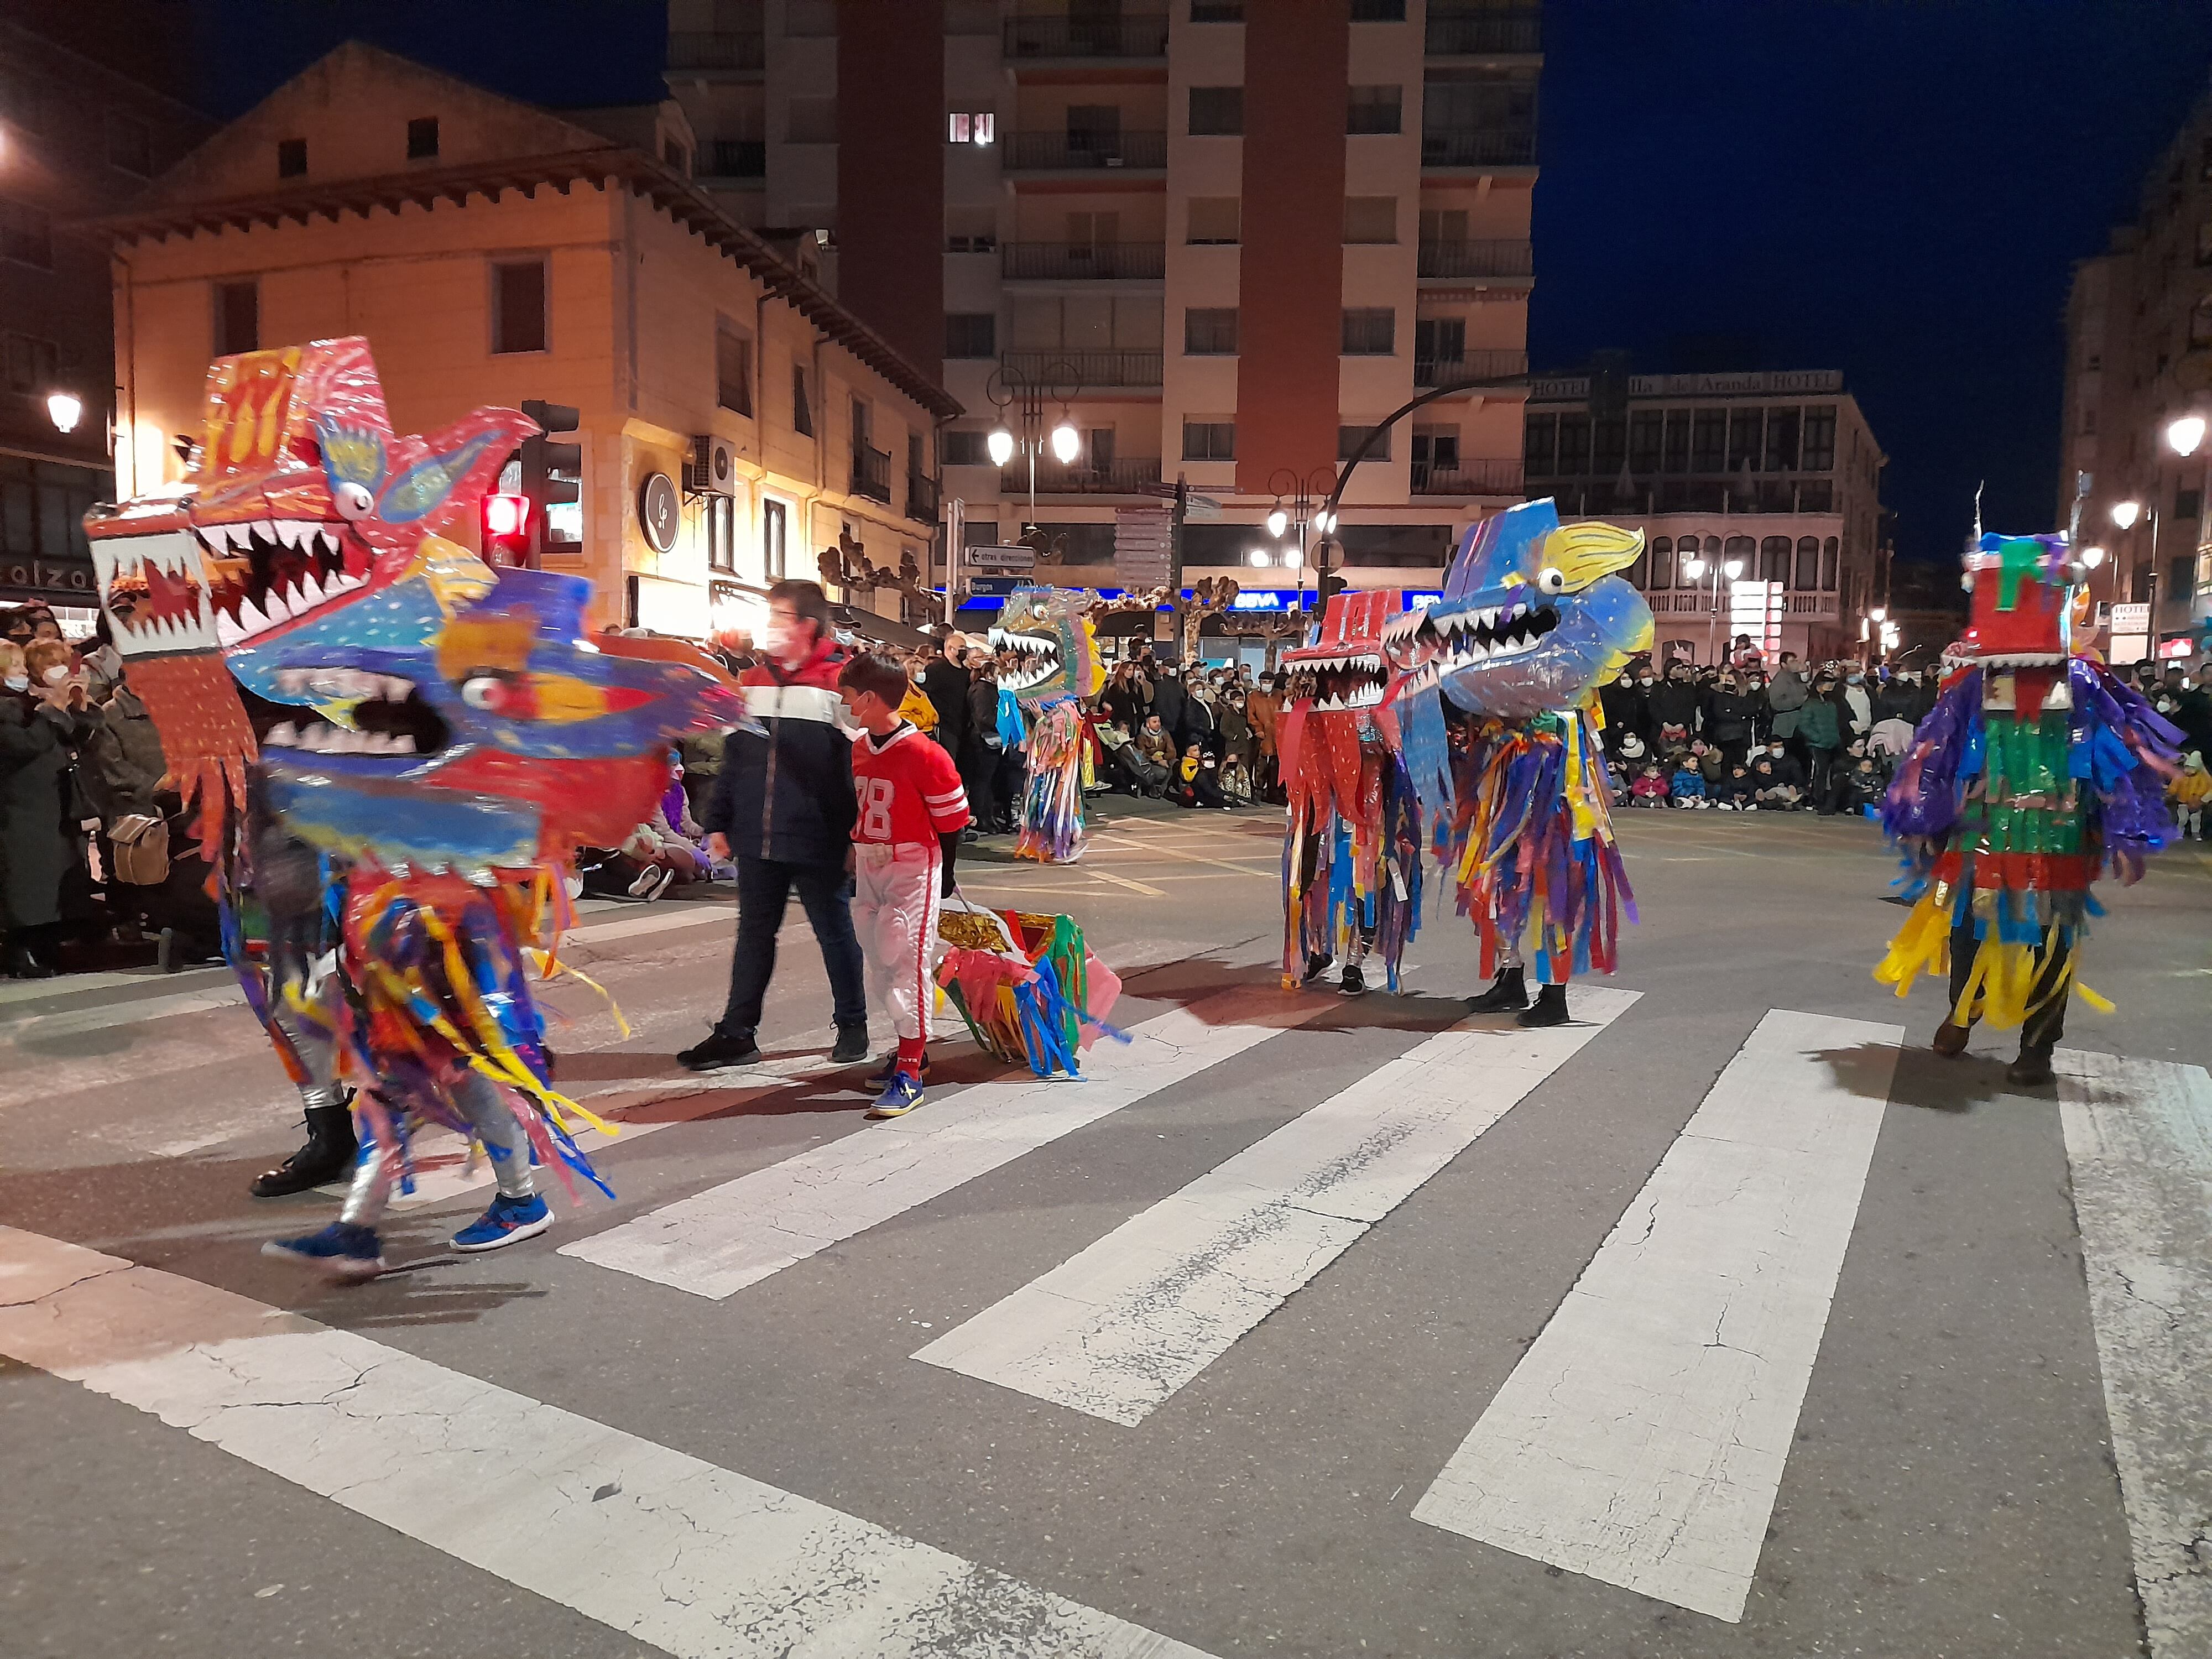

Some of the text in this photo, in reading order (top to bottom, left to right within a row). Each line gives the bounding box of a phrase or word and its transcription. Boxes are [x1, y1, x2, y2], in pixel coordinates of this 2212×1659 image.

[1700, 376, 1761, 390] Aranda
[1773, 373, 1833, 389] HOTEL
[971, 582, 993, 593] Burgos
[1234, 592, 1279, 608] BBVA
